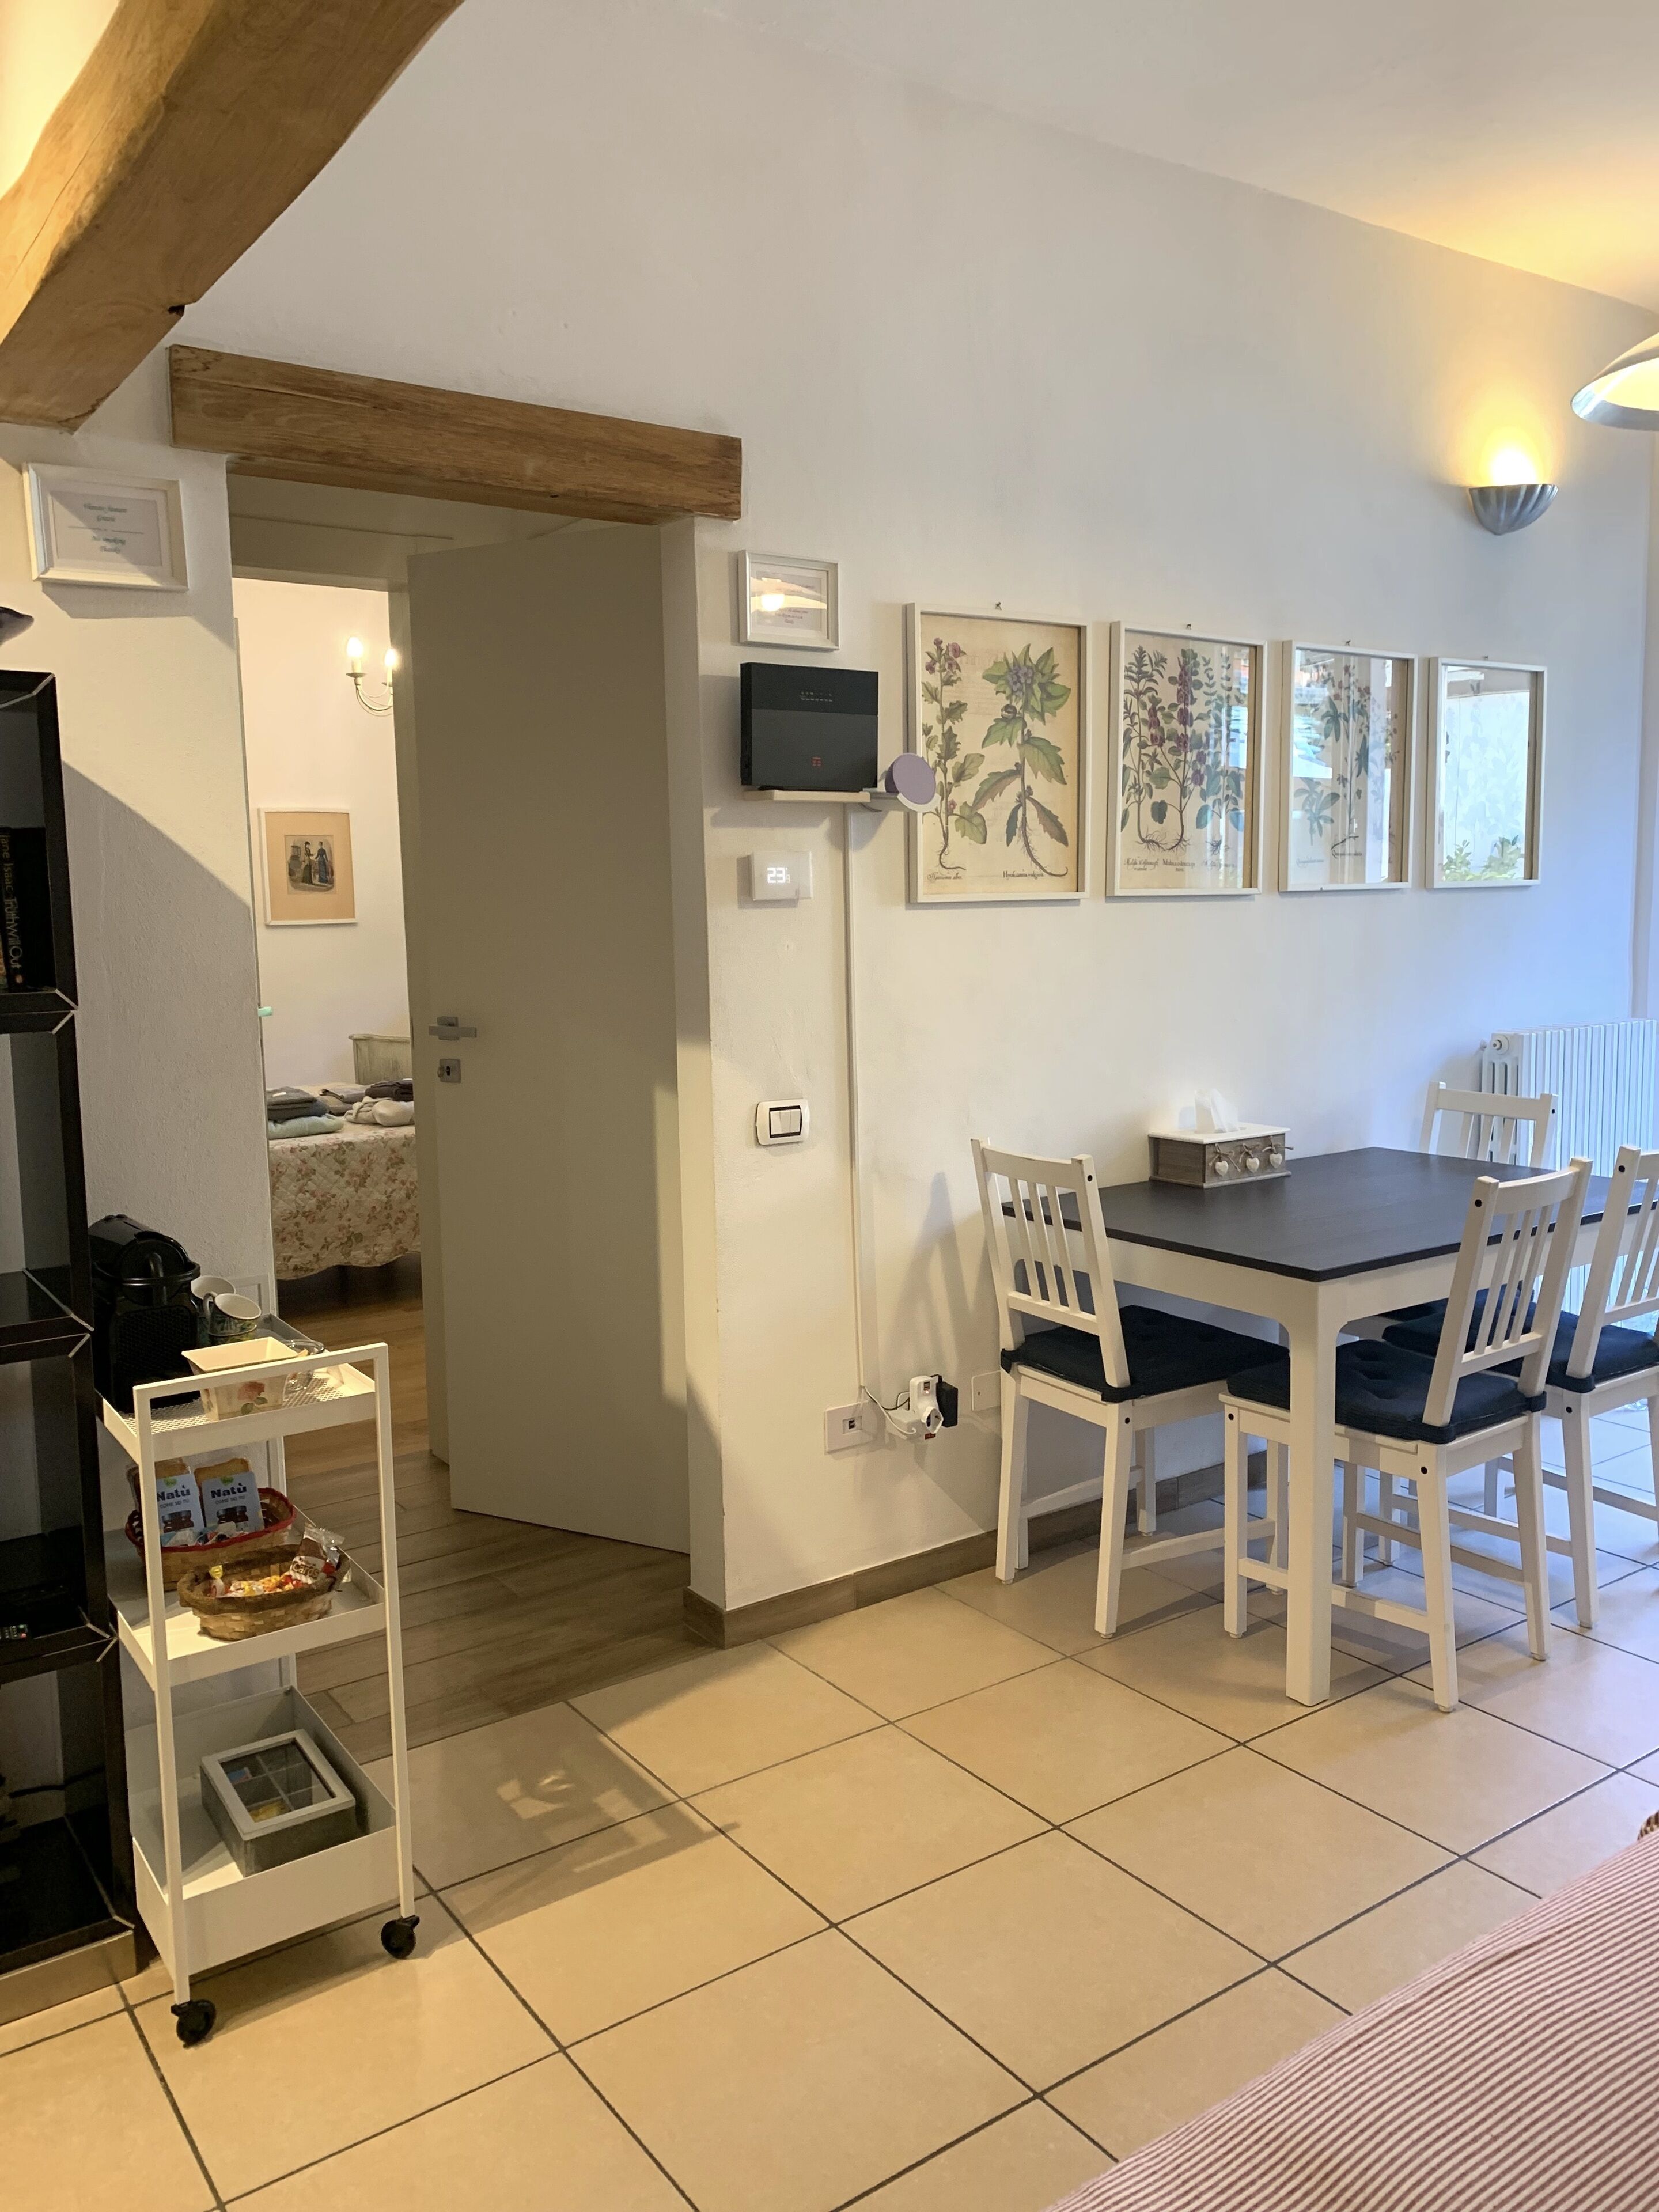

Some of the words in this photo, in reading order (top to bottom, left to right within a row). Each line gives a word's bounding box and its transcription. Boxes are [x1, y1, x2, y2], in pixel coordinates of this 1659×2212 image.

[3, 863, 14, 891] Isaac
[157, 1484, 191, 1502] Natù
[211, 1483, 247, 1498] Natù
